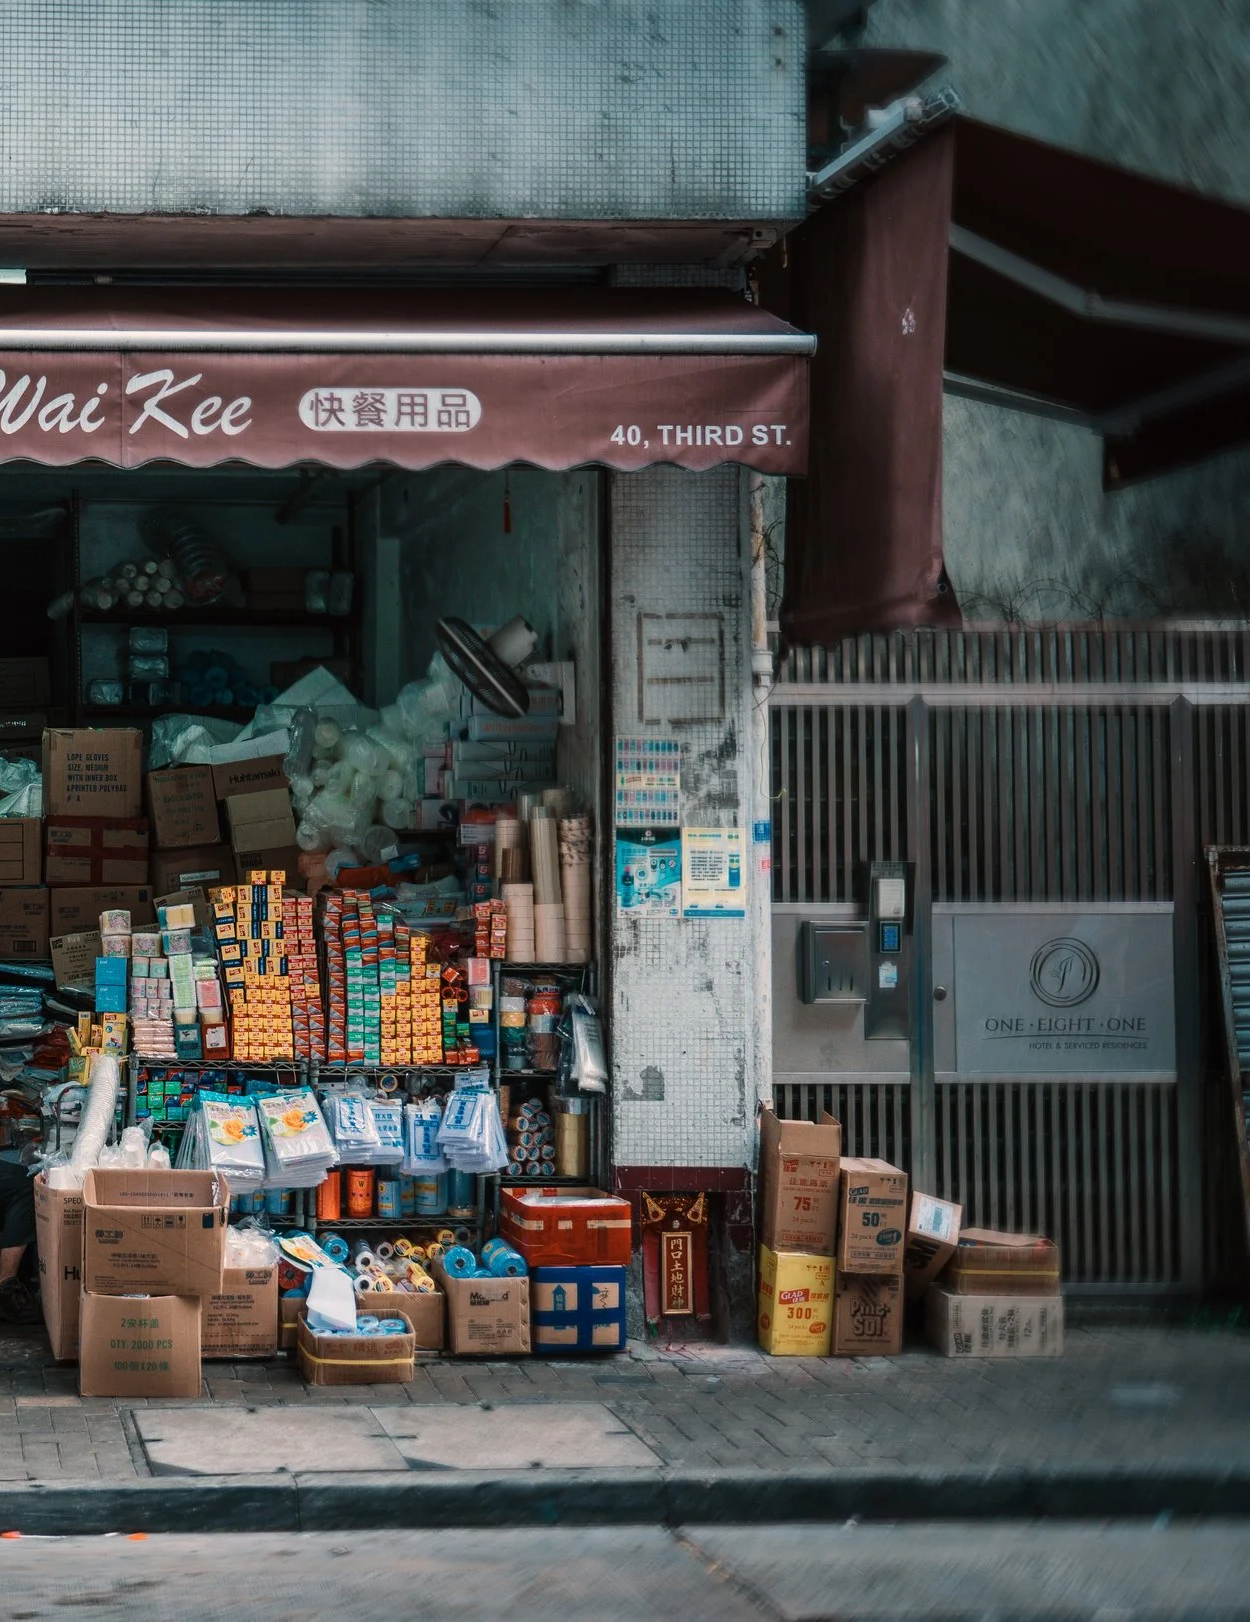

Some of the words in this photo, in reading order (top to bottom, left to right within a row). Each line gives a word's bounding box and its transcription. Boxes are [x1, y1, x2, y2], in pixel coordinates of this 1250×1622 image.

[125, 368, 253, 438] Kee
[309, 391, 473, 429] 快餐用品
[610, 425, 650, 450] 40,
[657, 425, 744, 447] THIRD
[752, 426, 793, 447] ST.
[228, 768, 282, 785] Huhtamaki
[985, 1018, 1025, 1032] ONE
[1037, 1018, 1095, 1032] EIGHT
[1107, 1017, 1147, 1032] ONE
[1029, 1042, 1053, 1050] HOTEL
[1064, 1042, 1100, 1050] SERVICED
[1102, 1041, 1148, 1050] RESIDENCES
[794, 1196, 811, 1211] 75
[862, 1212, 879, 1227] 50
[781, 1290, 803, 1301] GLAD
[787, 1306, 812, 1320] 300
[131, 1339, 154, 1350] 2000
[156, 1339, 173, 1350] PCS
